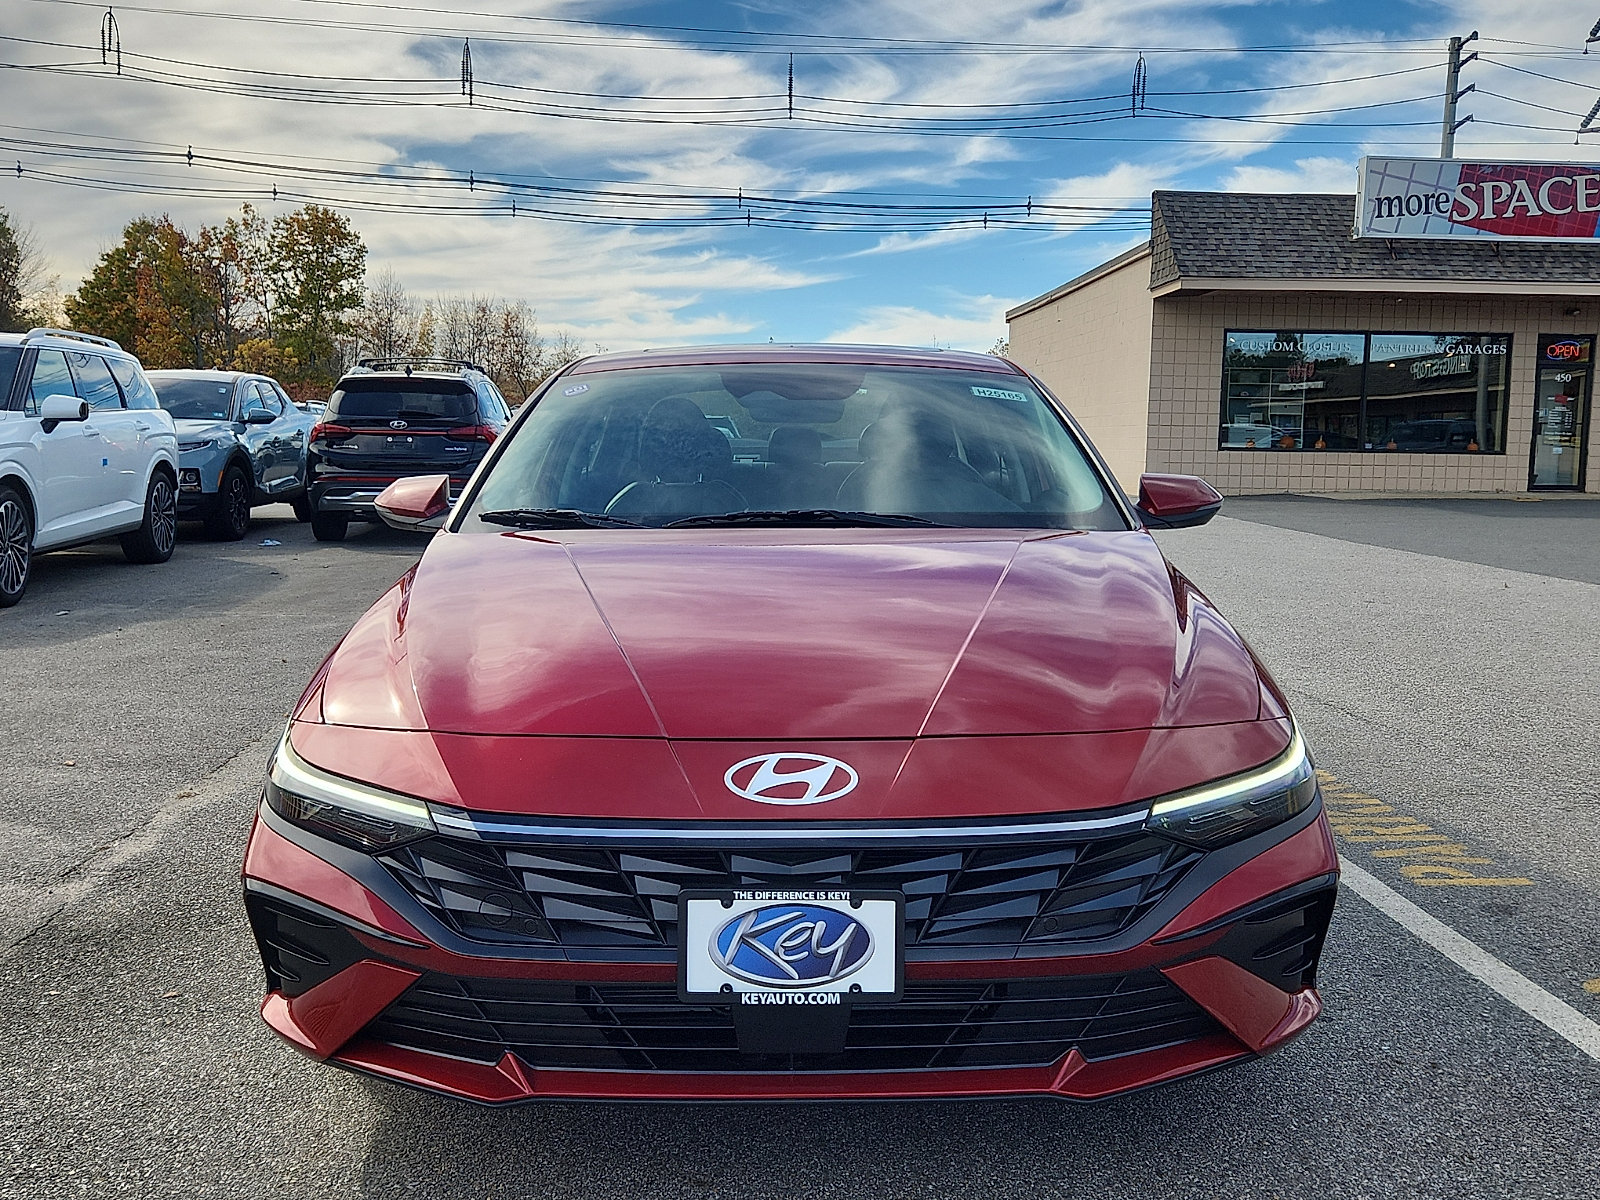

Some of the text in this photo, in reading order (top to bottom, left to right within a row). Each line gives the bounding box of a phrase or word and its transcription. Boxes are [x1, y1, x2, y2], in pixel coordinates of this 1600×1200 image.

[1239, 340, 1294, 352] CUSTOM
[1445, 344, 1507, 355] GARAGES
[1547, 344, 1580, 357] OPEN
[1554, 373, 1572, 383] 450
[733, 891, 753, 900] THE
[755, 891, 815, 900] DIFFERENCE
[817, 891, 826, 900] IS
[723, 911, 857, 980] Key
[741, 992, 841, 1005] KEYAUTO.COM
